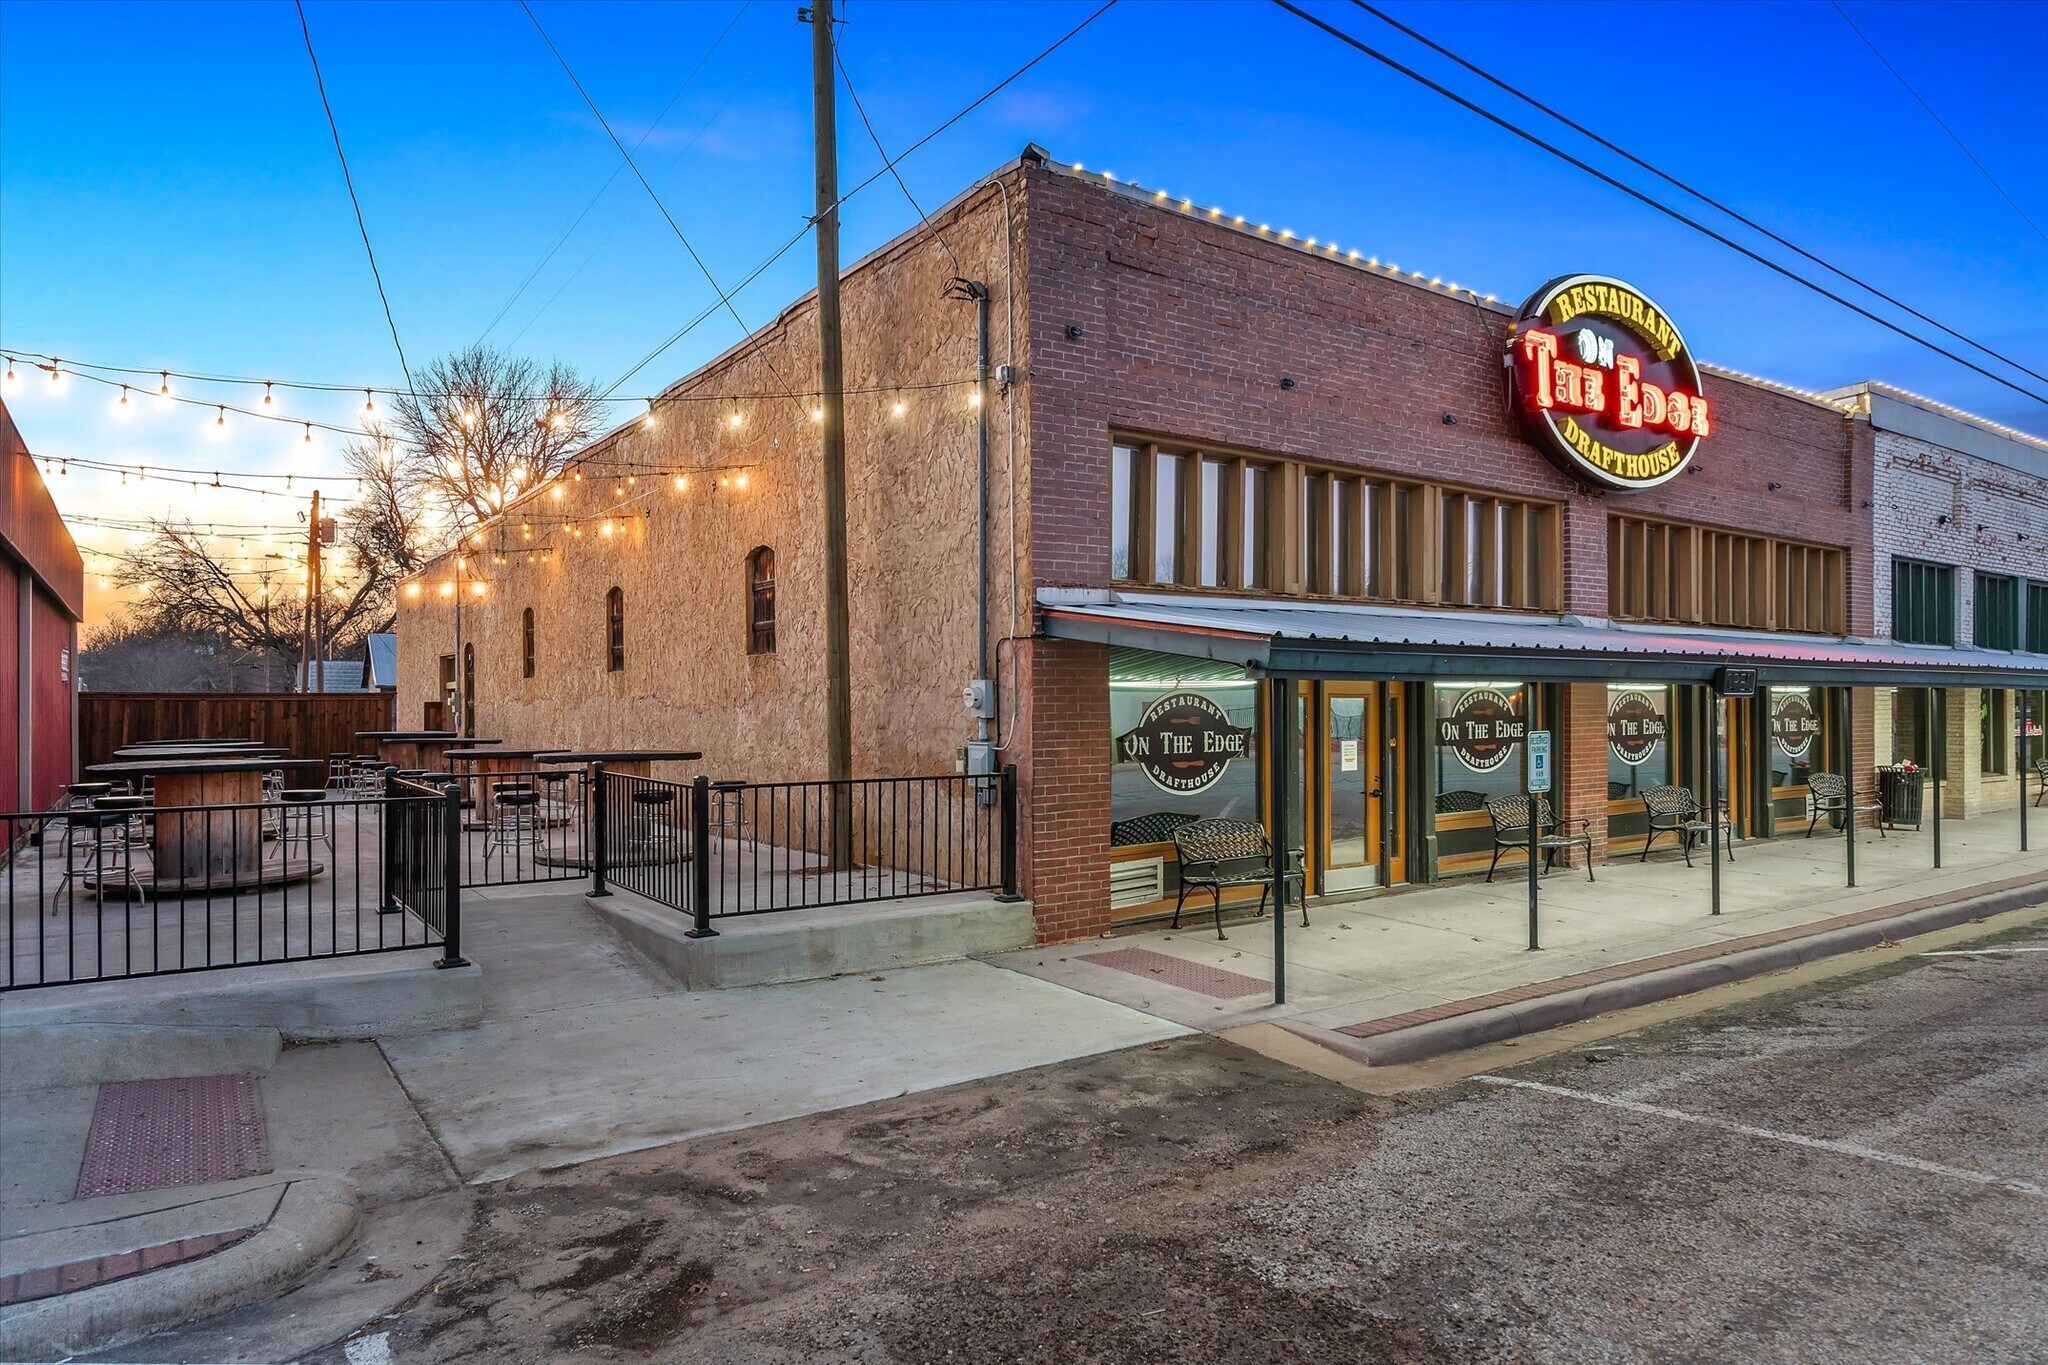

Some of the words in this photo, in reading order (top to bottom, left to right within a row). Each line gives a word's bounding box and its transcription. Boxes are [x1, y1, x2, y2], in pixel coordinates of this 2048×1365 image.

[1556, 285, 1682, 360] RESTAURANT
[1577, 328, 1614, 369] ON
[1525, 329, 1605, 411] THE
[1616, 354, 1710, 437] EDGE
[1563, 416, 1681, 478] DRAFTHOUSE
[1150, 696, 1222, 722] RESTAURANT
[1459, 692, 1509, 713] RESTAURANT
[1441, 721, 1460, 740] ON
[1465, 721, 1489, 739] THE
[1495, 720, 1524, 738] EDGE
[1620, 719, 1638, 736] THE
[1160, 732, 1193, 754] THE
[1203, 730, 1244, 753] EDGE
[1460, 745, 1508, 768] DRAFTHOUSE
[1152, 762, 1220, 789] DRAFTHOUSE
